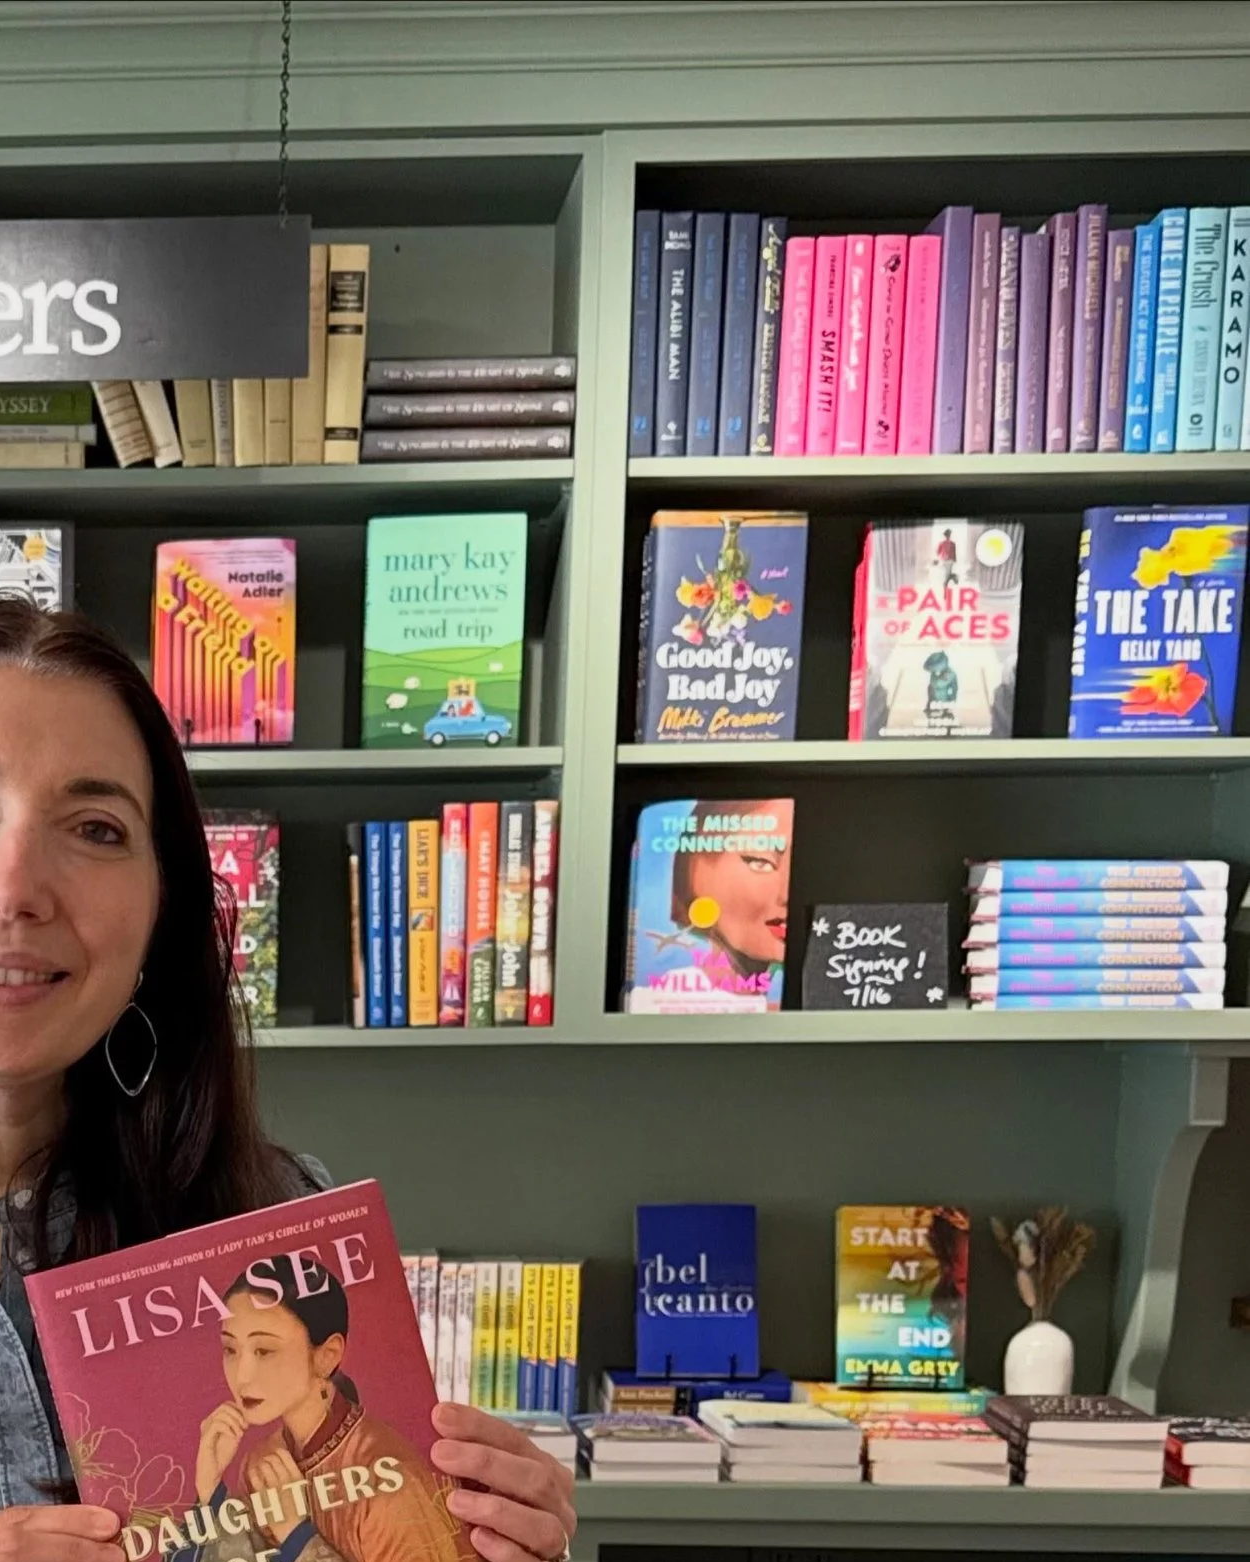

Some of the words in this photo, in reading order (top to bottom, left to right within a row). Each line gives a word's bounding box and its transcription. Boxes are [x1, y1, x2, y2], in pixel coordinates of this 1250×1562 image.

[672, 269, 684, 296] THE
[670, 300, 683, 338] ALIBI
[1224, 239, 1247, 385] KARAMO
[668, 343, 681, 381] MAN
[819, 330, 836, 385] SMASH
[817, 390, 833, 413] IT!
[383, 551, 456, 575] mary
[464, 542, 516, 575] kay
[228, 569, 284, 585] Natalie
[242, 585, 284, 600] Adler
[388, 579, 510, 605] andrews
[897, 585, 979, 612] PAIR
[1094, 590, 1150, 635] THE
[1162, 589, 1235, 633] TAKE
[403, 619, 448, 641] road
[456, 620, 494, 642] trip
[884, 620, 910, 637] OF
[918, 614, 1012, 640] ACES
[655, 640, 736, 669] Good
[733, 641, 794, 676] Joy,
[1120, 640, 1161, 661] KELLY
[1165, 639, 1201, 661] YANG
[667, 673, 726, 700] Bad
[725, 673, 781, 708] Joy
[662, 816, 697, 833] THE
[703, 815, 778, 832] MISSED
[416, 828, 429, 867] LIAR'S
[478, 840, 490, 872] MAY
[651, 835, 786, 853] CONNECTION
[417, 871, 428, 899] DICE
[477, 876, 489, 930] HOUSE
[832, 922, 907, 950] BOOK
[843, 988, 892, 1008] 7/16
[850, 1228, 929, 1247] START
[55, 1287, 72, 1300] NEW
[74, 1280, 96, 1294] YORK
[97, 1273, 121, 1288] TIMES
[121, 1261, 171, 1281] BESTSELLING
[173, 1251, 204, 1268] AUTHOR
[205, 1248, 216, 1258] OF
[217, 1239, 244, 1256] LADY
[246, 1232, 275, 1247] TAN'S
[275, 1222, 311, 1239] CIRCLE
[313, 1216, 326, 1229] OF
[328, 1206, 369, 1225] WOMEN
[654, 1252, 708, 1286] bel
[887, 1260, 920, 1281] AT
[71, 1274, 234, 1359] LISA
[243, 1230, 376, 1312] SEE
[656, 1292, 755, 1314] canto
[855, 1293, 906, 1314] THE
[897, 1327, 951, 1348] END
[845, 1359, 903, 1376] EMMA
[908, 1360, 960, 1378] GREY
